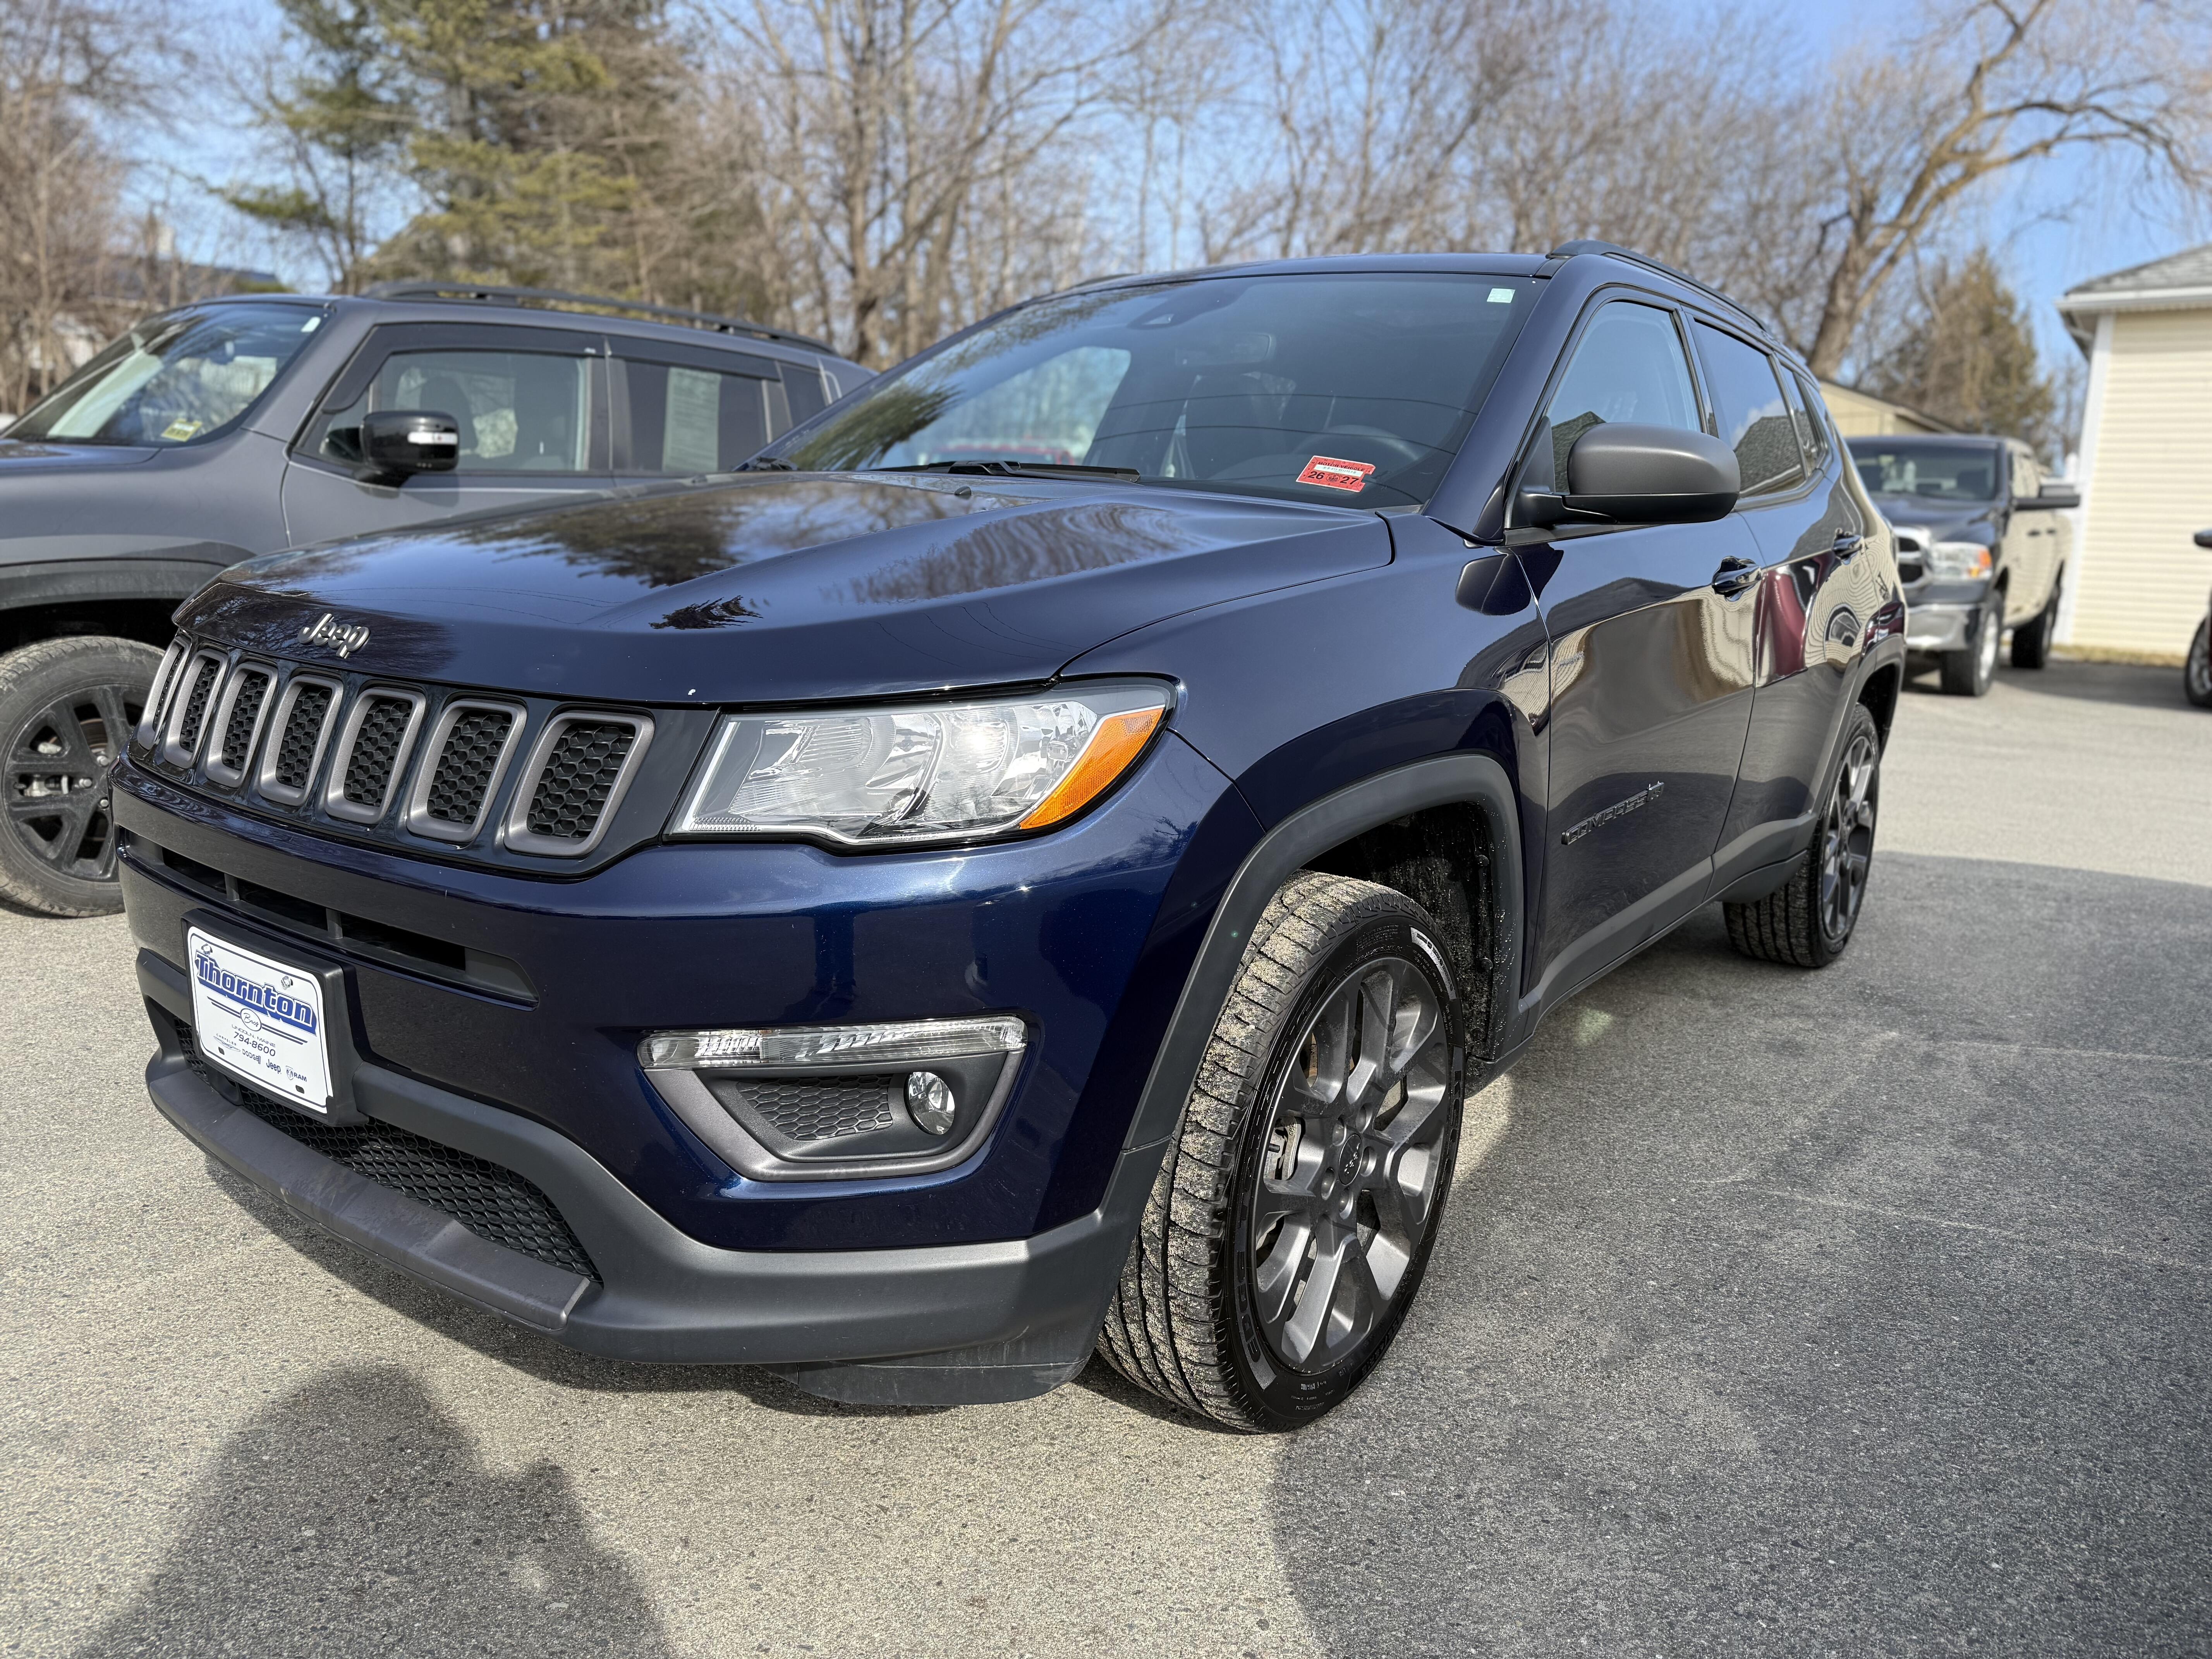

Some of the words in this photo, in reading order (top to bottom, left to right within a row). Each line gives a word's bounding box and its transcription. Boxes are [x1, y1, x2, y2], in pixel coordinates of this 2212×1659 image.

[1307, 471, 1325, 479] 26
[1340, 476, 1359, 484] 27
[297, 613, 370, 658] Jeep
[195, 951, 314, 1029] Thornton
[244, 1013, 259, 1027] Bros
[216, 1033, 237, 1046] CHRYSLER
[234, 1031, 276, 1056] 794-8600
[242, 1049, 259, 1061] DODGE
[266, 1059, 281, 1074] Jeep
[294, 1072, 307, 1082] RAM
